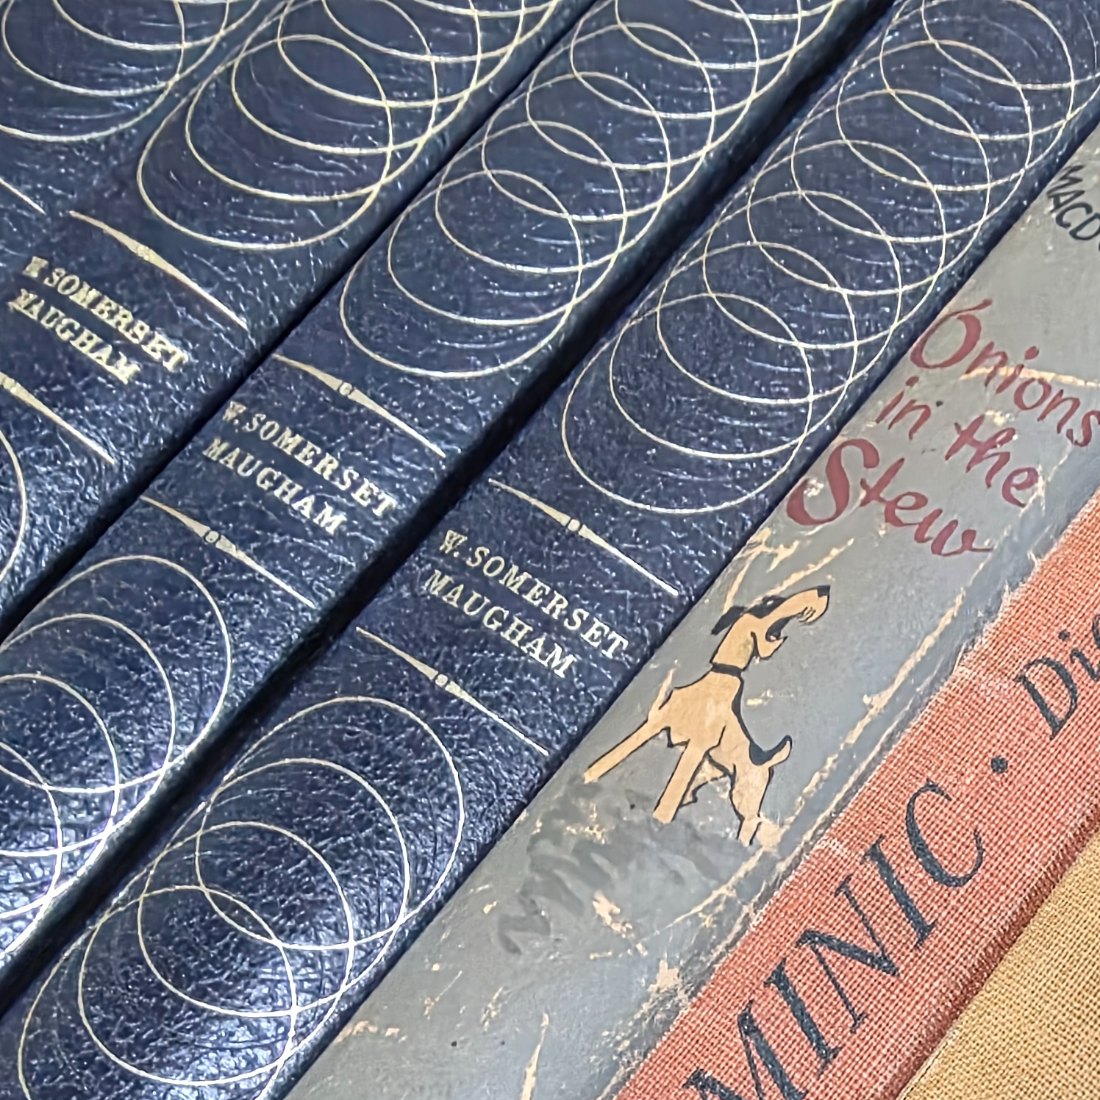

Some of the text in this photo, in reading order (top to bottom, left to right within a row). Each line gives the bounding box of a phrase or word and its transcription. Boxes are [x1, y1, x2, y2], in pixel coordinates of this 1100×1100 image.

[8, 288, 141, 385] MAUGHAM
[43, 267, 189, 373] SOMERSET
[202, 437, 348, 536] MAUGHAM
[243, 412, 399, 517] SOMERSET
[875, 376, 1041, 509] in the
[787, 438, 994, 557] Stew
[422, 569, 577, 679] MAUGHAM
[440, 529, 629, 659] W. SOMERSET
